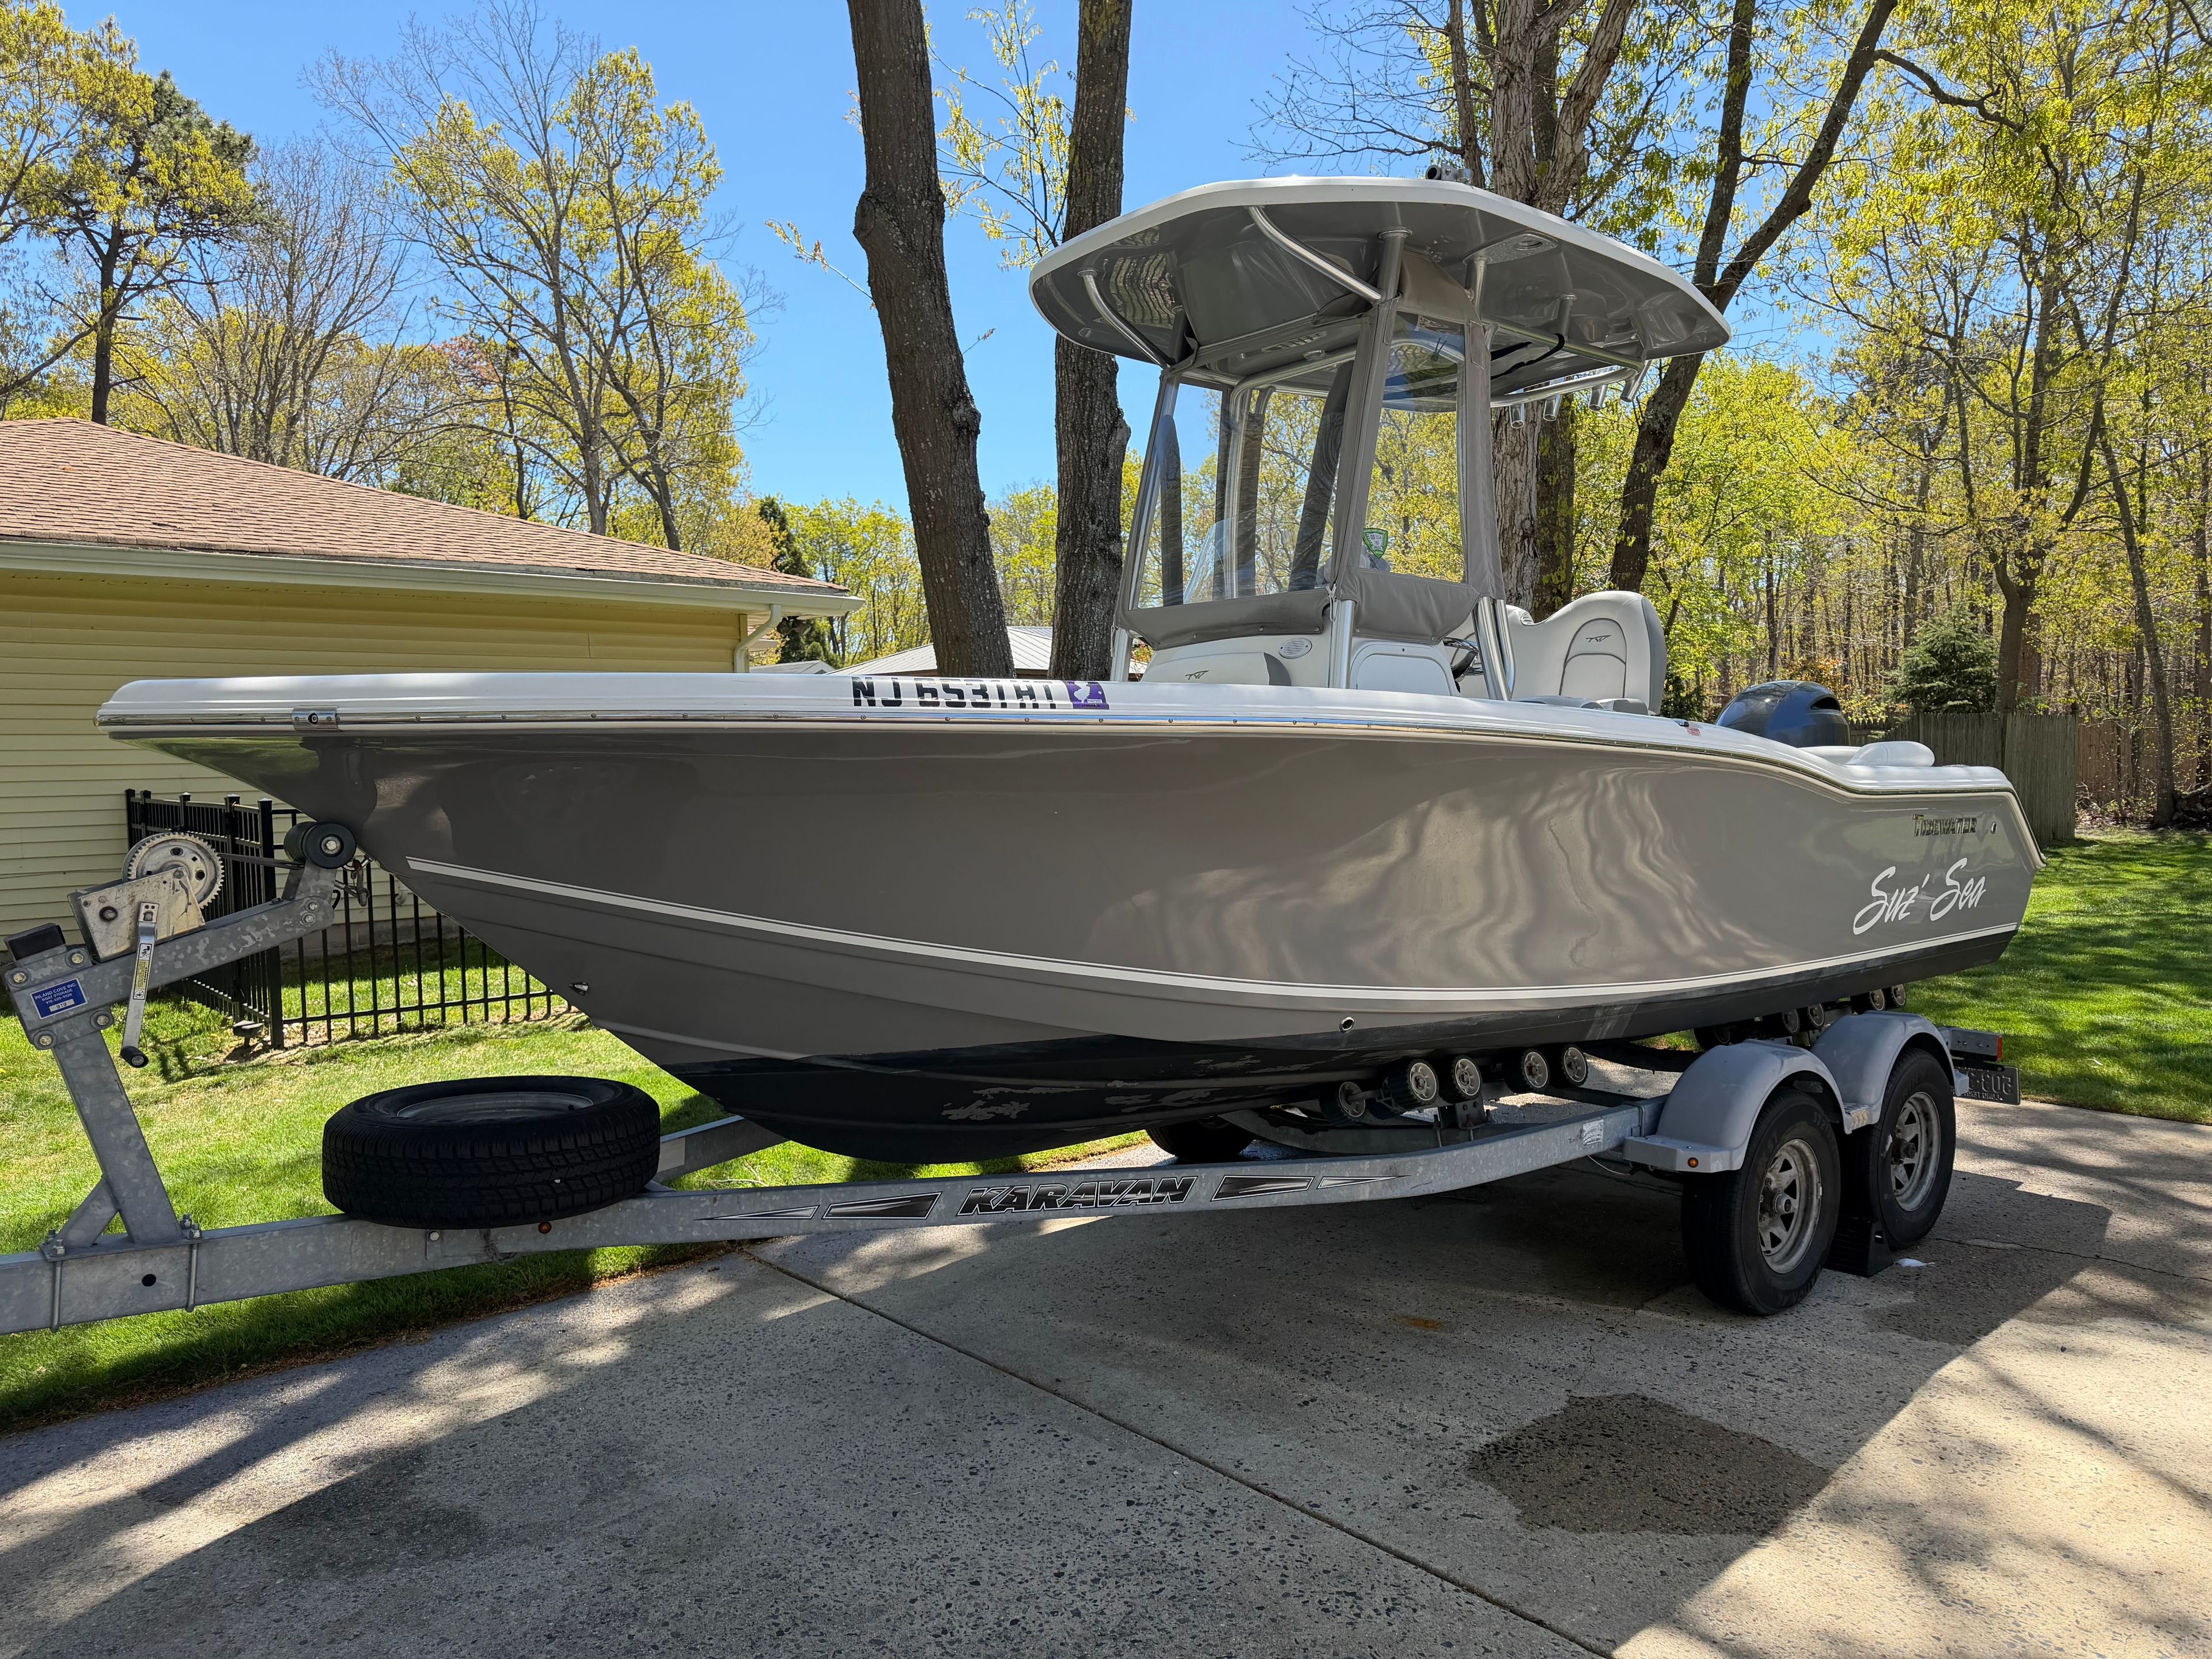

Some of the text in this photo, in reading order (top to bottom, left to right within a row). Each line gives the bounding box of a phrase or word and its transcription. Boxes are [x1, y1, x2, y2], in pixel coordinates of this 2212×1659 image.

[851, 676, 903, 707] NJ
[1930, 857, 1986, 921] Sea
[34, 991, 53, 999] INLAND
[956, 1176, 1199, 1217] KARAVAN
